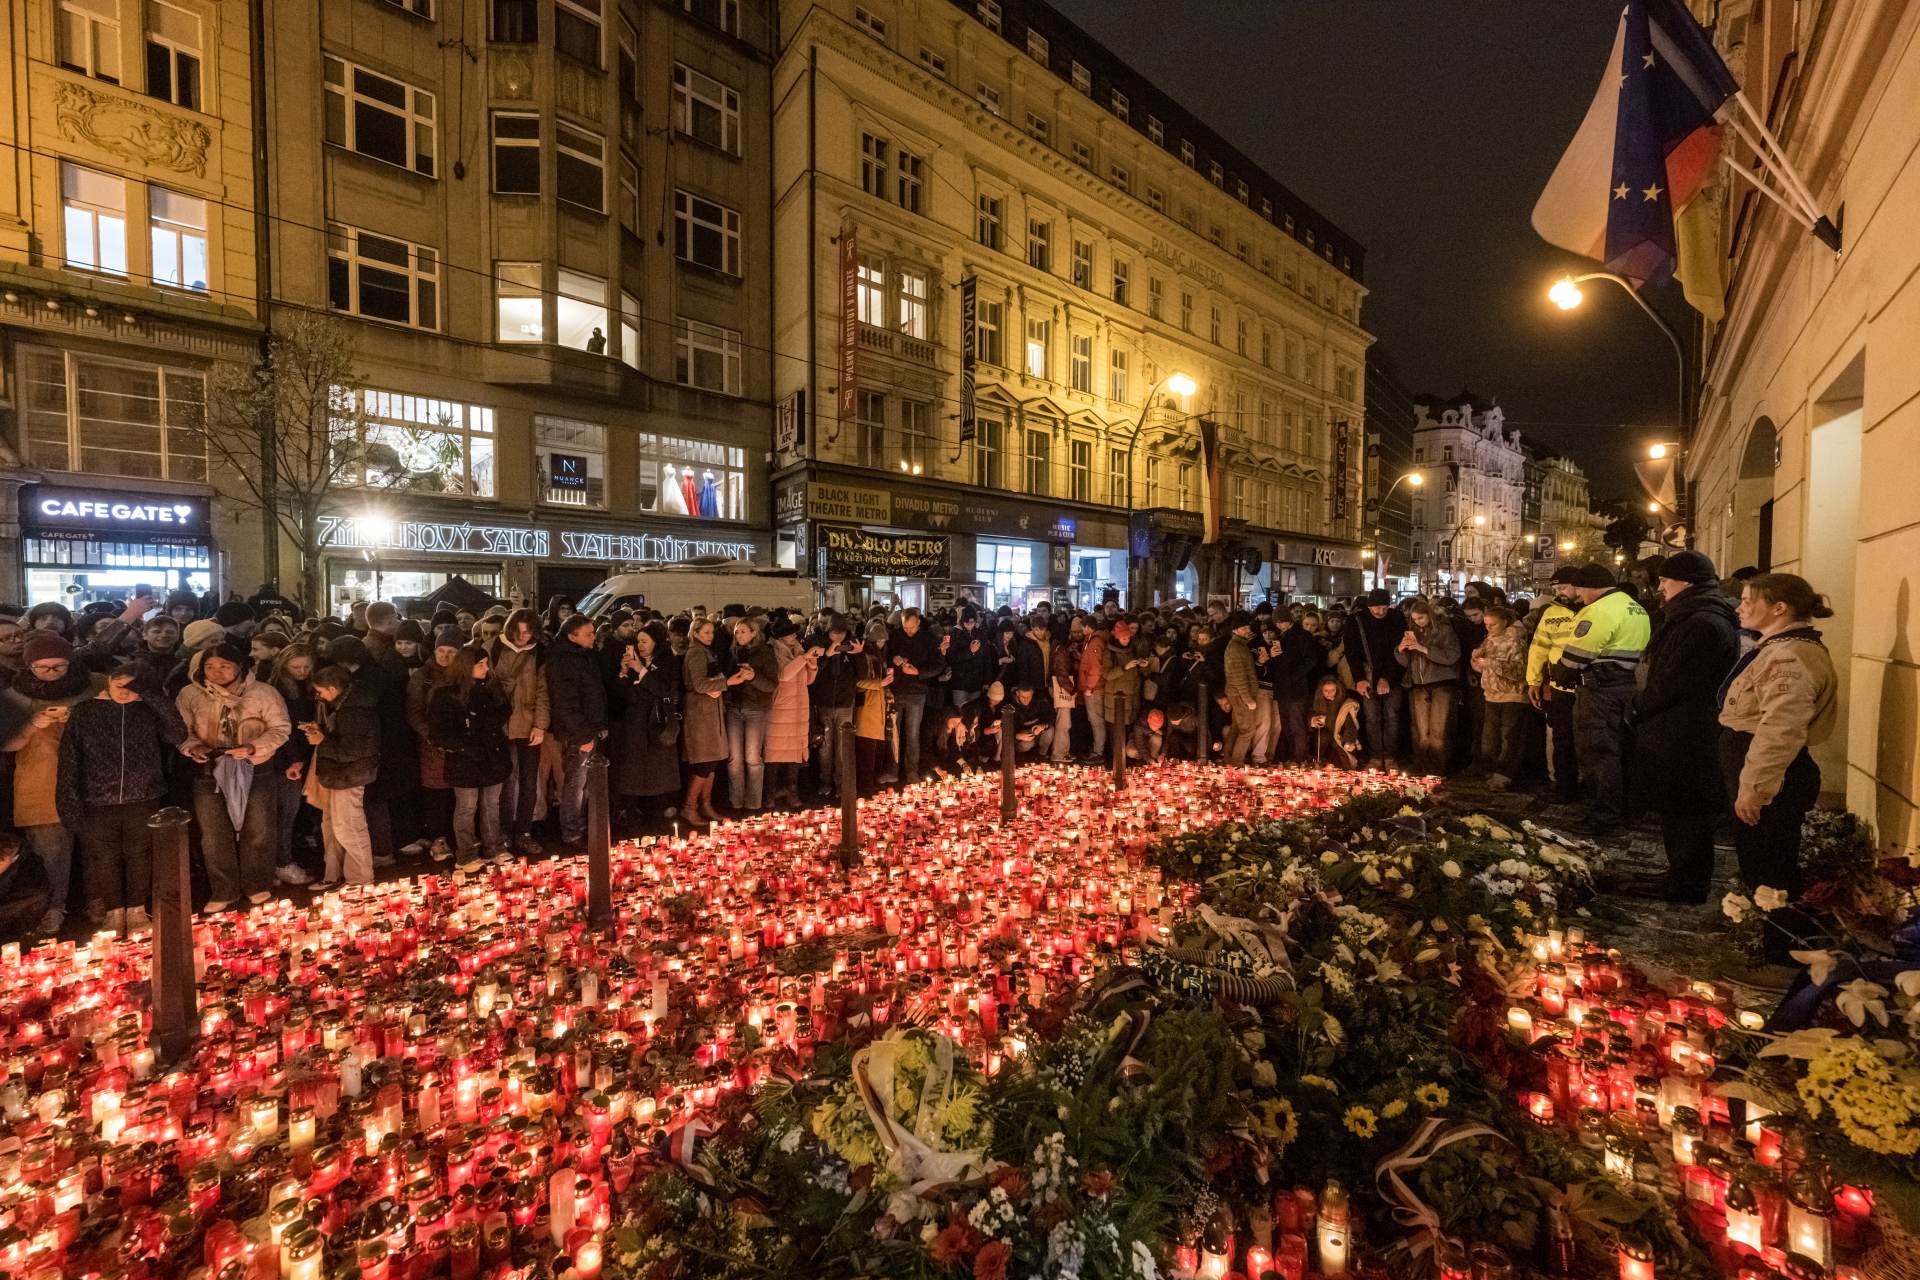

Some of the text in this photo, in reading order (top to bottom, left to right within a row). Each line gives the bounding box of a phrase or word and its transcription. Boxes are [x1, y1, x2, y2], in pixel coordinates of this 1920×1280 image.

[964, 290, 975, 357] IMAGE
[553, 475, 585, 484] NUANCE
[777, 487, 804, 513] IMAGE
[818, 487, 880, 505] BLACK LIGHT
[41, 500, 173, 522] CAFE GATE
[809, 501, 852, 518] THEATRE
[856, 507, 888, 520] METRO
[895, 497, 959, 515] DIVADLO METRO
[41, 531, 88, 540] CAFE GATE
[1052, 523, 1072, 532] MUSIC
[482, 528, 549, 557] SALON
[561, 532, 649, 561] SVATEBNÍ
[654, 534, 689, 562] DŮM
[895, 539, 943, 554] METRO
[1537, 536, 1551, 552] P
[1315, 547, 1336, 565] KFC
